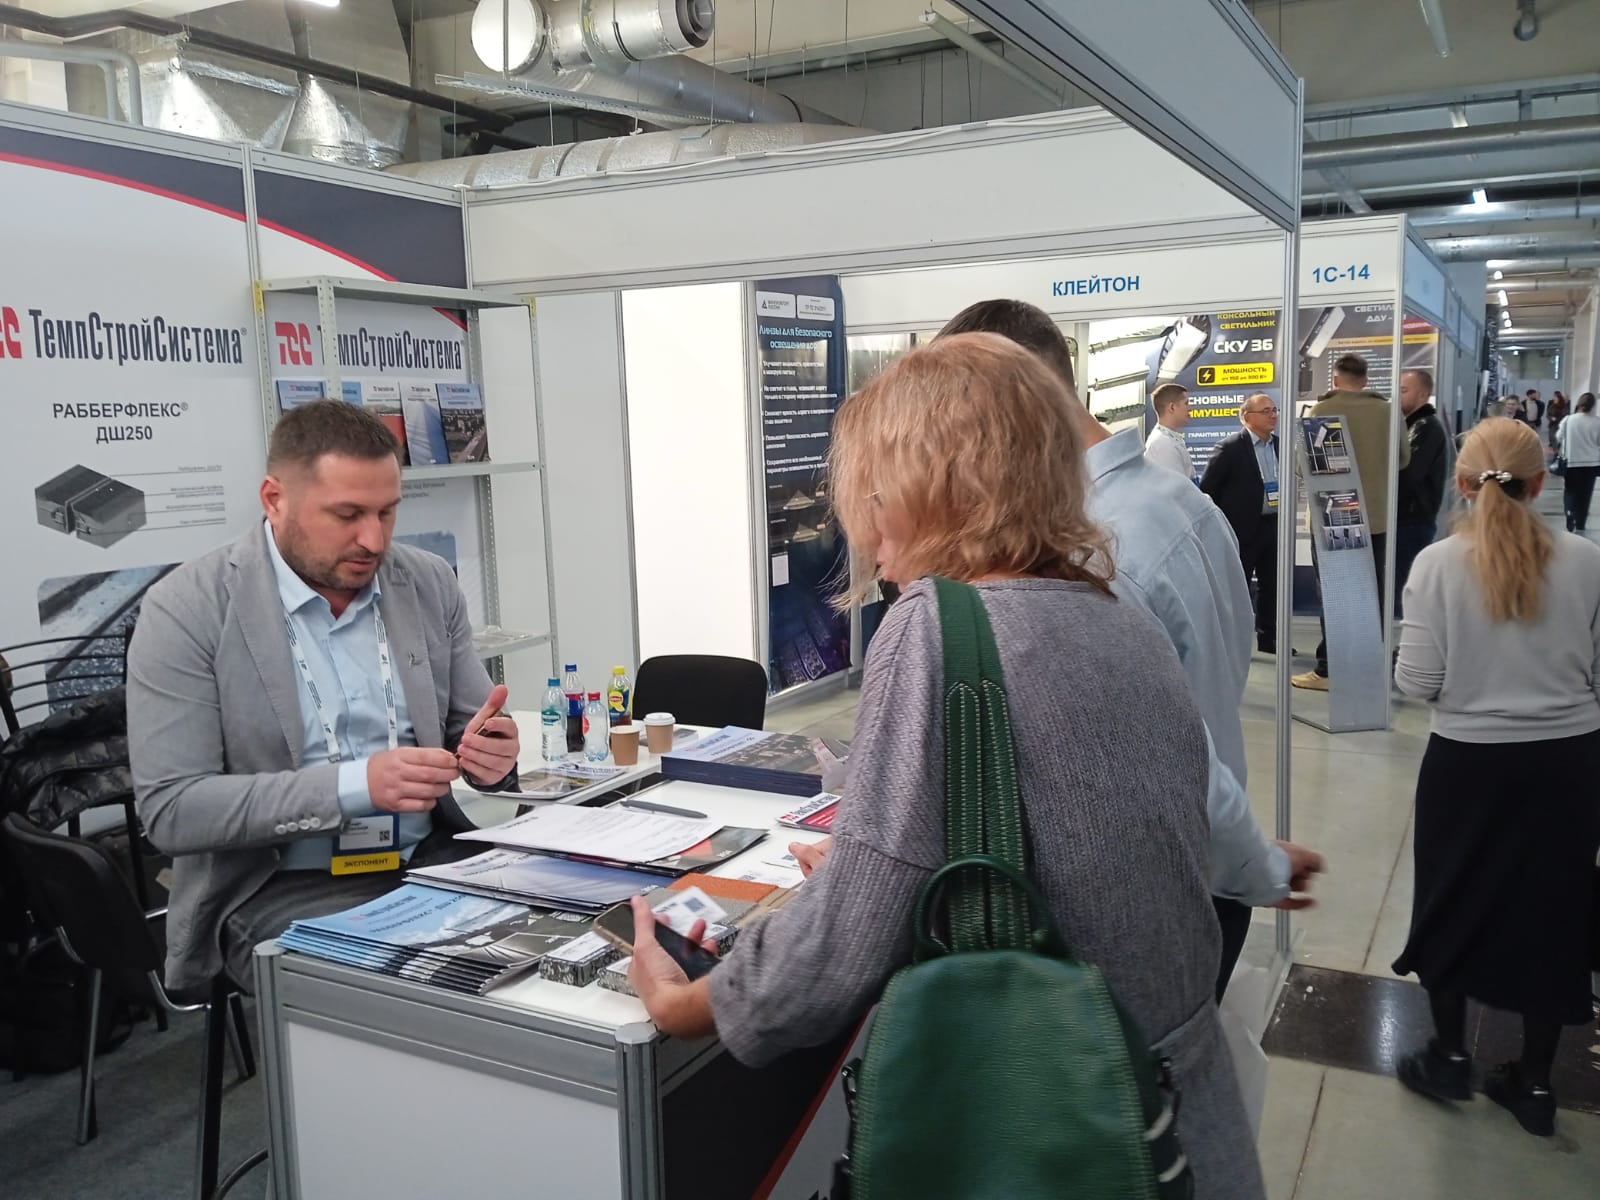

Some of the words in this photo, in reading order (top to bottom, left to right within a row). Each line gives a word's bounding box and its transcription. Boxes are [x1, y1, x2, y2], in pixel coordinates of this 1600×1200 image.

[1312, 264, 1371, 284] 1С-14
[1052, 275, 1140, 297] КЛЕЙТОН
[1220, 321, 1276, 329] СВЕТИЛЬНИК
[1213, 339, 1249, 354] СКУ
[1251, 338, 1274, 352] 36
[1223, 366, 1267, 375] МОЩНОСТЬ
[1188, 394, 1245, 405] СНОВНЫЕ
[96, 425, 153, 444] ДШ250
[343, 858, 389, 868] ЭКСПОНЕНТ
